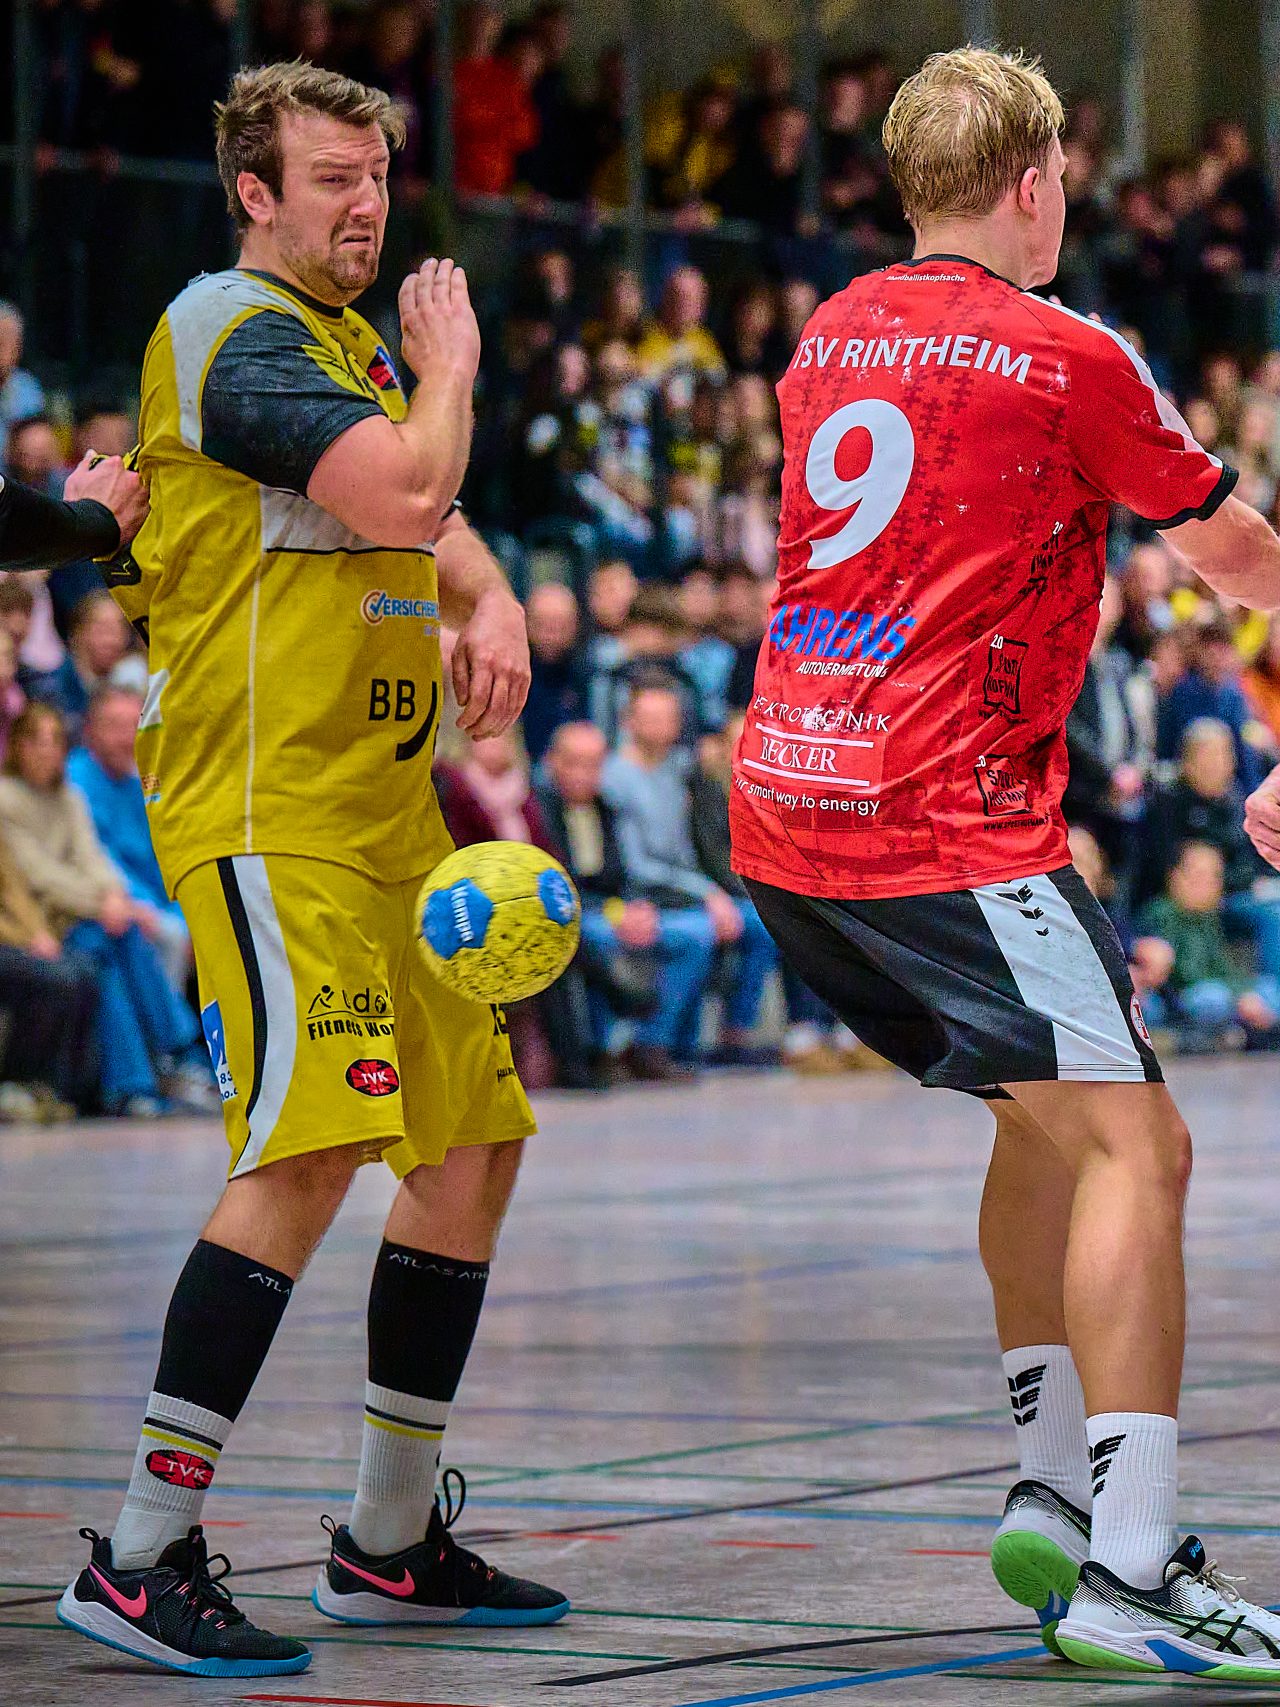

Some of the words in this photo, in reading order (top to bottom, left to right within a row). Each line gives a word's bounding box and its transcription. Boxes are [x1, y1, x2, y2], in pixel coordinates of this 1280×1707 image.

[840, 335, 1033, 384] RINTHEIM
[806, 398, 915, 570] 9
[769, 604, 917, 661] AHRENS
[760, 736, 838, 773] BECKER
[747, 783, 775, 801] smart
[776, 791, 799, 812] way
[802, 793, 816, 808] to
[820, 799, 881, 816] energy
[361, 1071, 388, 1085] TVK
[167, 1461, 206, 1480] TVK
